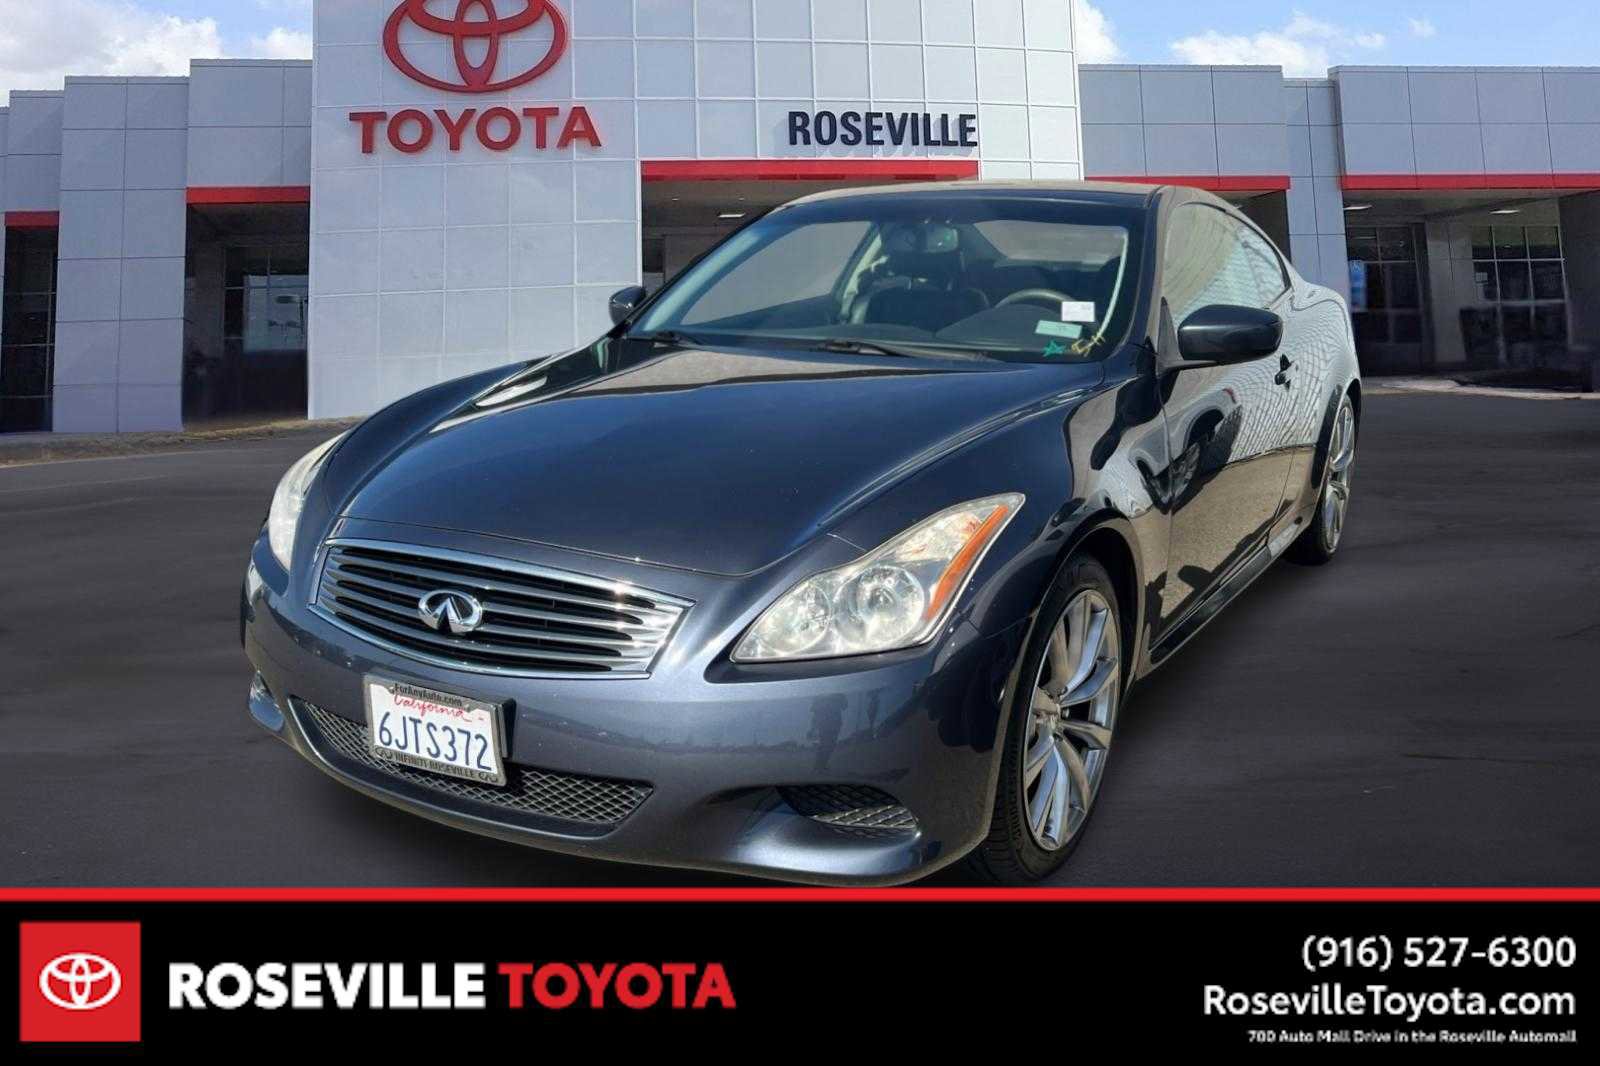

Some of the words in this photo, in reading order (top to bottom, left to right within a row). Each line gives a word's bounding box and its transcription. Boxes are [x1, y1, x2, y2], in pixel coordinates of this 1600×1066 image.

[350, 107, 602, 153] TOYOTA
[789, 111, 977, 147] ROSEVILLE
[394, 694, 470, 720] California
[379, 711, 492, 771] 6JTS372
